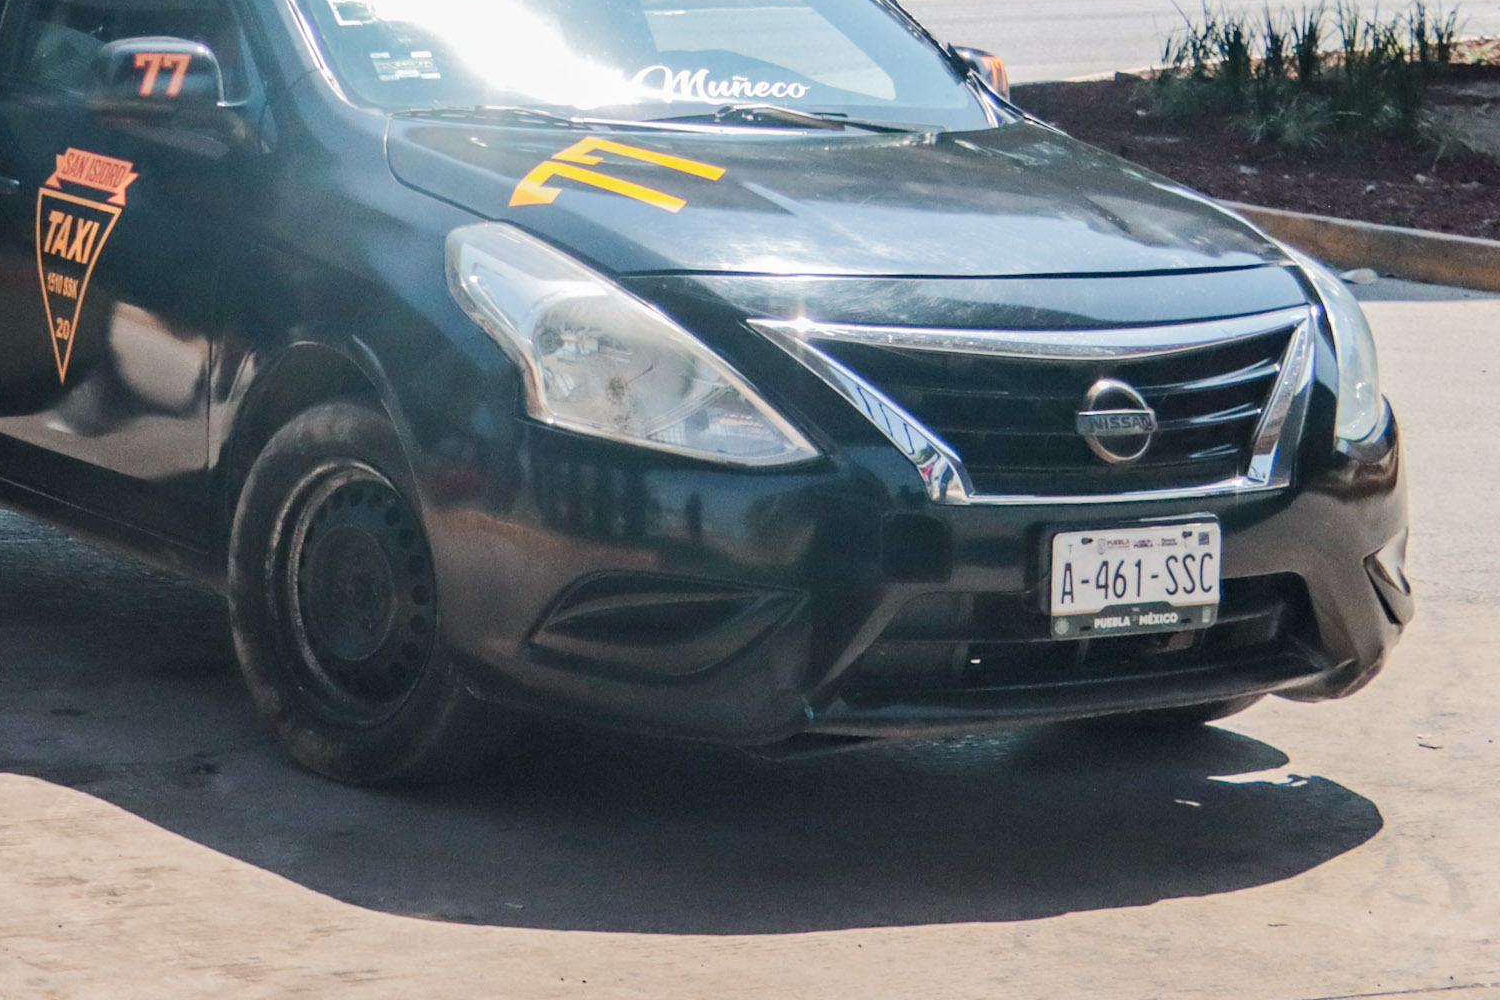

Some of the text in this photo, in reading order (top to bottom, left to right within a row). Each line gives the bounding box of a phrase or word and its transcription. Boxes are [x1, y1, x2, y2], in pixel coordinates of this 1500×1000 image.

[133, 52, 192, 97] 77
[62, 152, 127, 188] SAN ISIDRO
[508, 136, 727, 214] 77
[44, 210, 100, 264] TAXI
[56, 317, 70, 340] 20
[1092, 414, 1153, 431] NISSAN
[1061, 552, 1213, 605] A-461-SSC
[1094, 612, 1179, 629] PUEBLA MÉXICO
